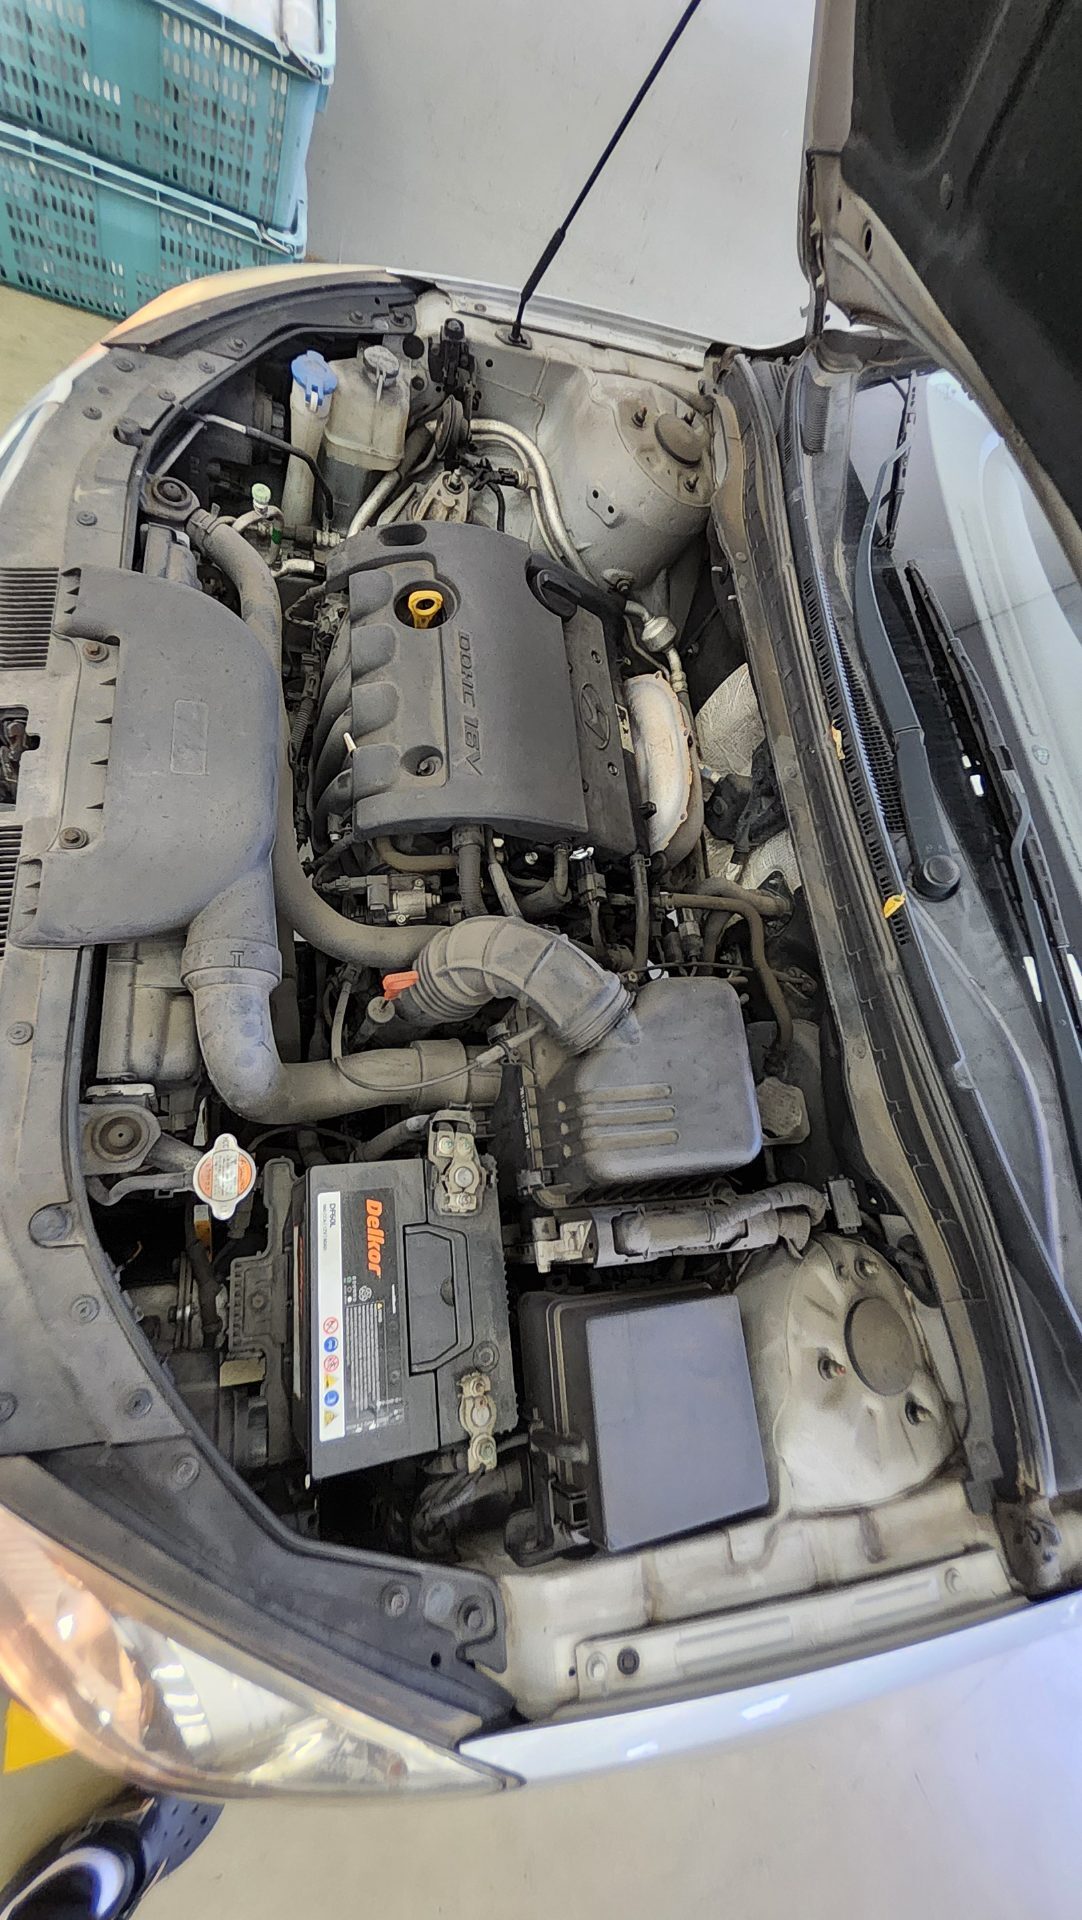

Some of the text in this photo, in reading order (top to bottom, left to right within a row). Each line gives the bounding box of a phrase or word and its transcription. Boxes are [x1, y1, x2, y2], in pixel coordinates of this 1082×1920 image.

[459, 631, 483, 776] DOHC 16V
[366, 1199, 385, 1279] Delkor
